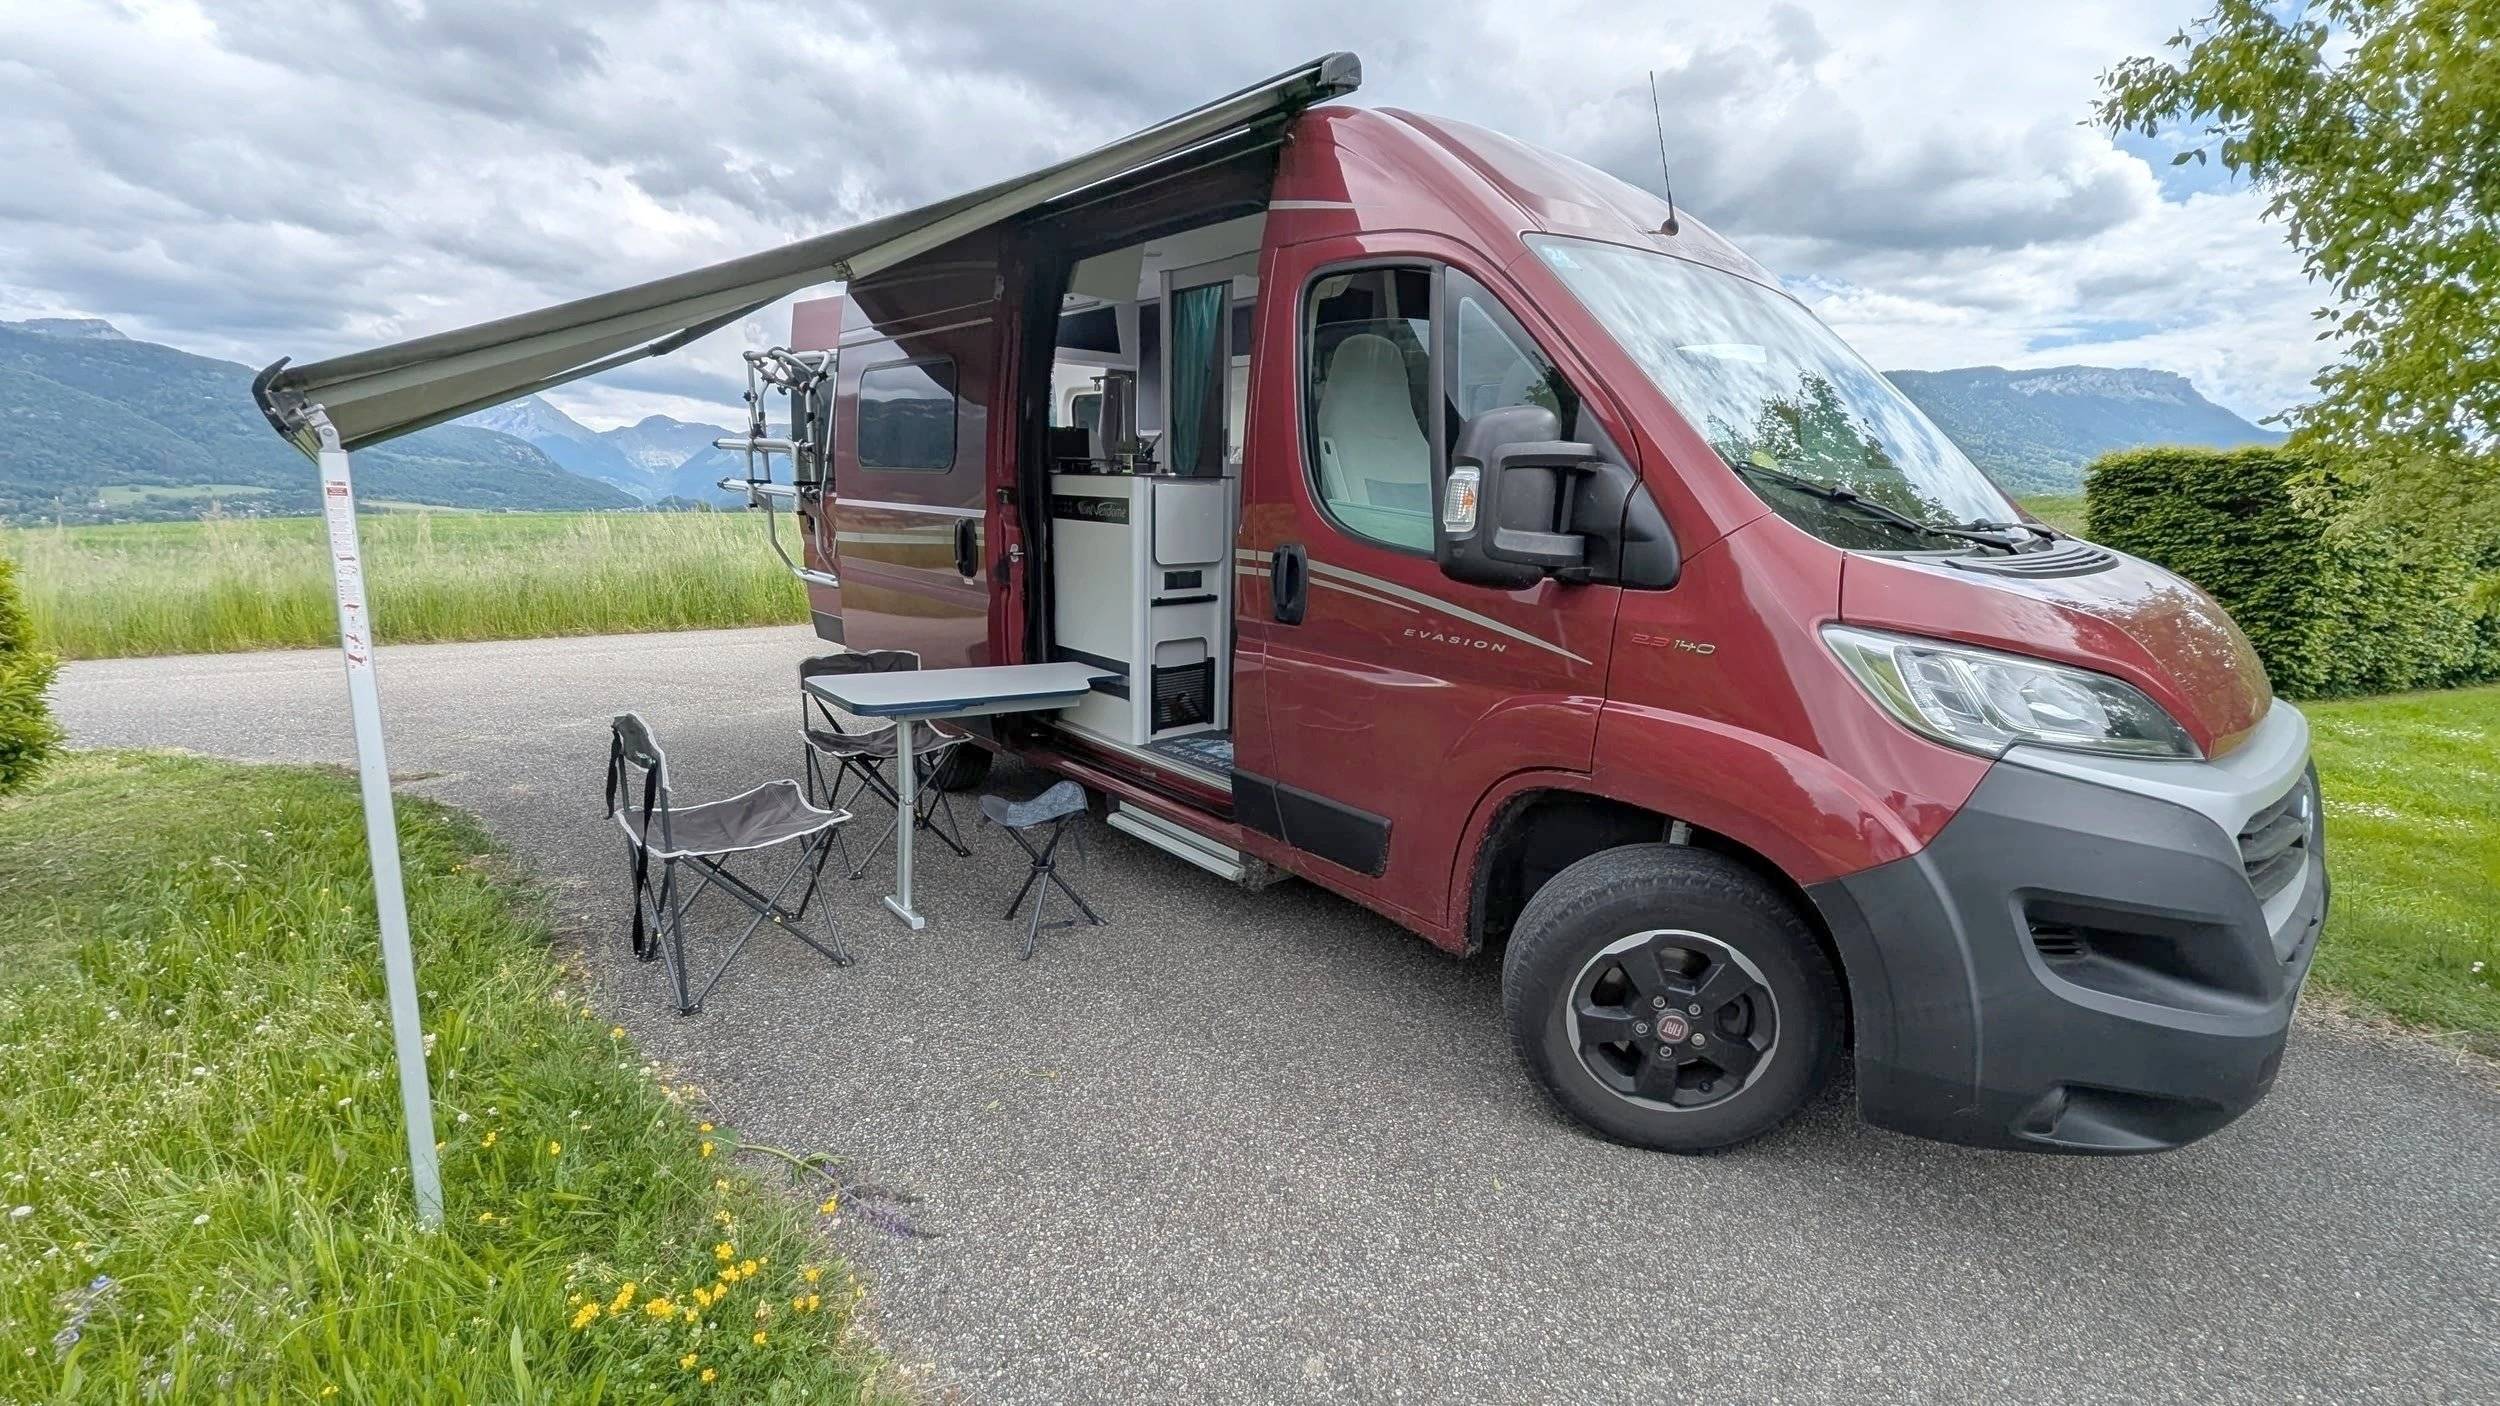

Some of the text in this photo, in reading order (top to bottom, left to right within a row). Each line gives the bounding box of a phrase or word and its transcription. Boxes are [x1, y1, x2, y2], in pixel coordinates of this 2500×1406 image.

[1403, 628, 1507, 652] EVASION
[1673, 640, 1716, 655] 140
[1662, 1021, 1683, 1037] FIAT
